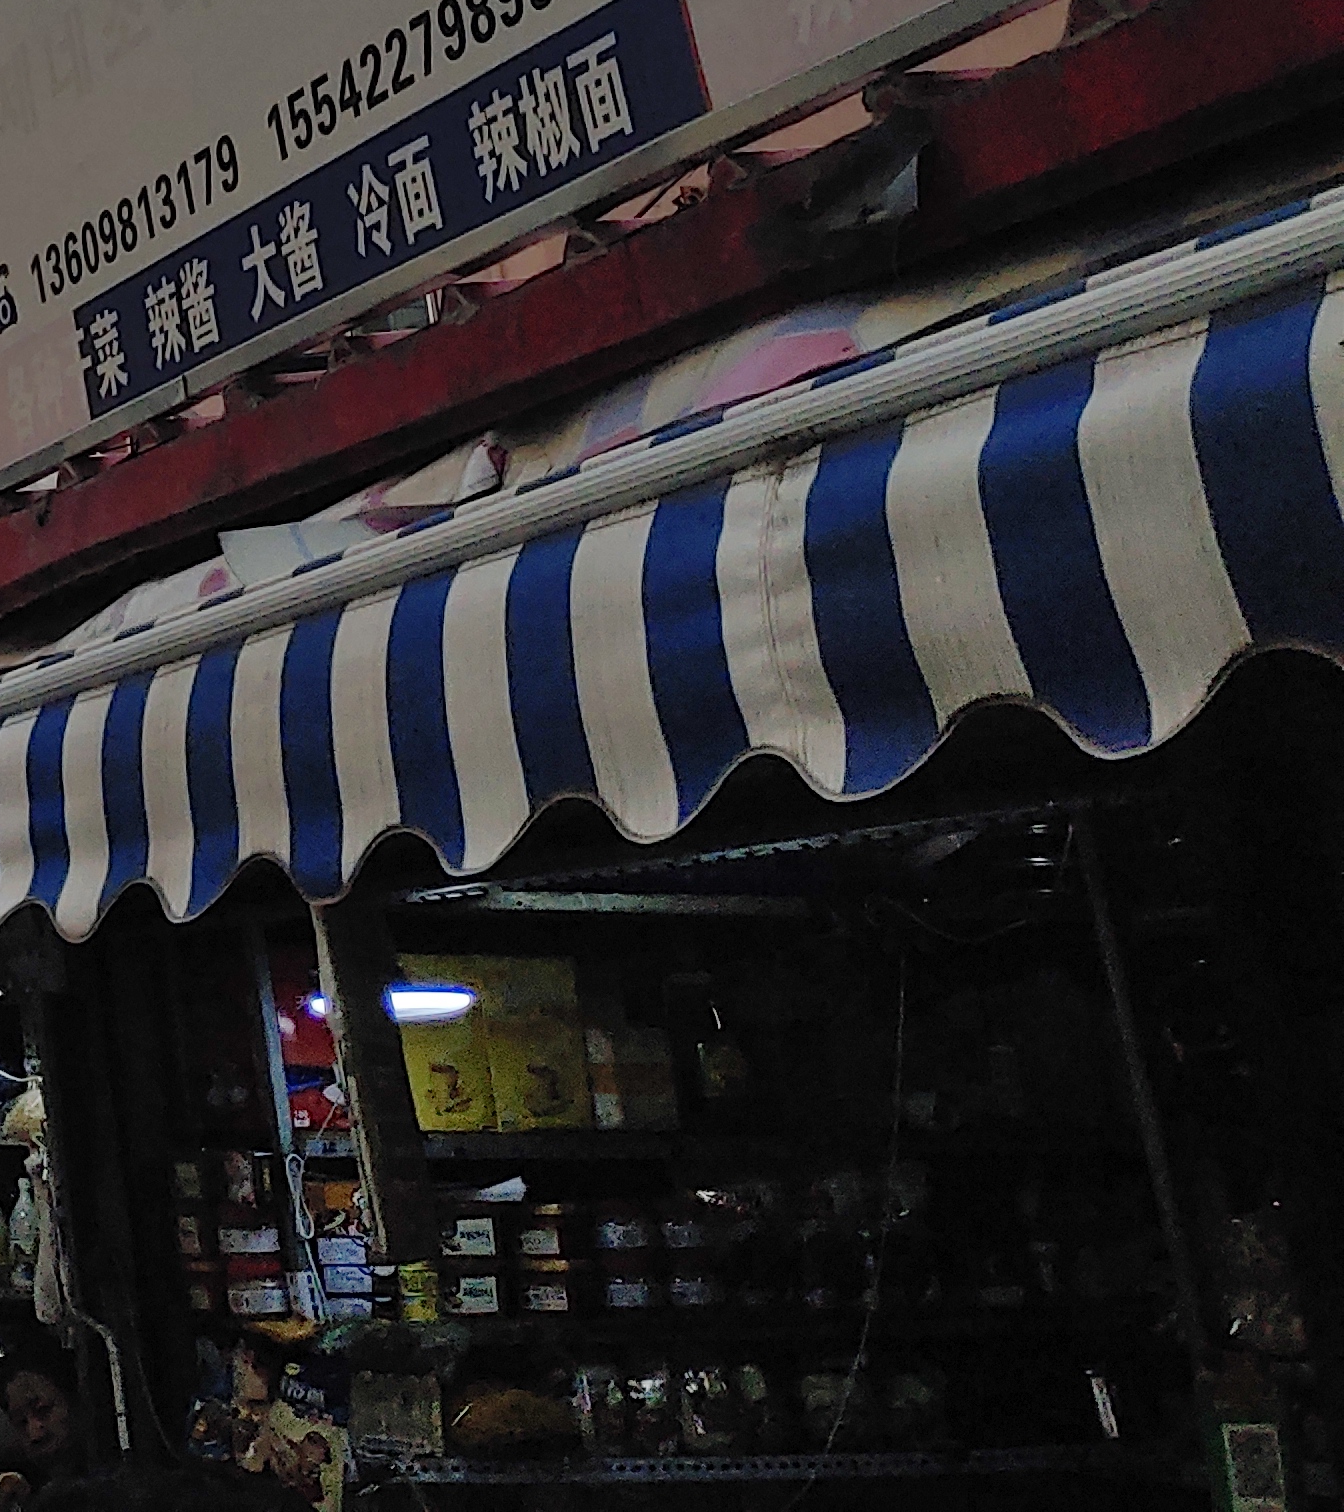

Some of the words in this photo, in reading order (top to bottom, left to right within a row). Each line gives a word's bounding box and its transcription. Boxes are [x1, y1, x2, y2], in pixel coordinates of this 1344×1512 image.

[28, 133, 240, 304] 13609813179
[143, 256, 222, 372] 辣酱
[241, 200, 326, 324] 大酱
[346, 134, 445, 259] 冷面
[468, 30, 635, 204] 辣椒面
